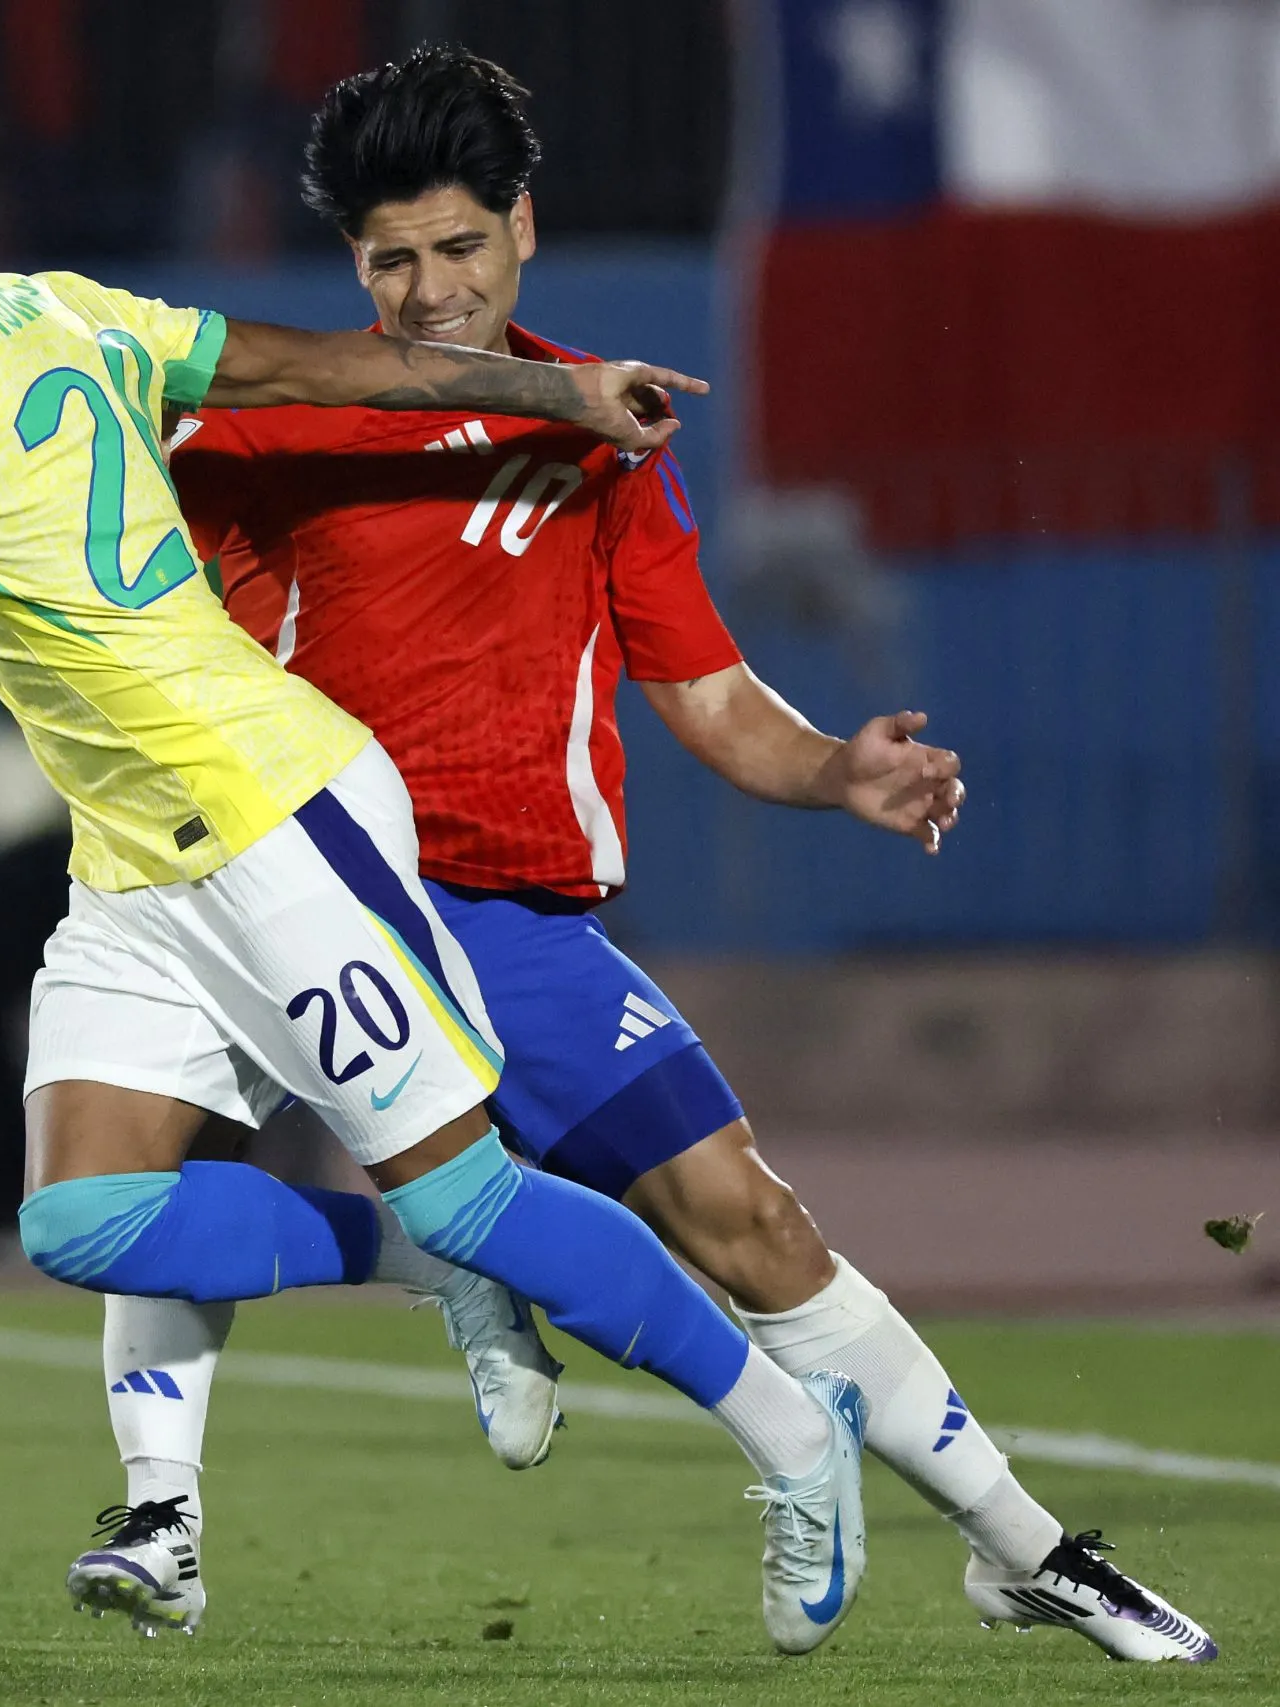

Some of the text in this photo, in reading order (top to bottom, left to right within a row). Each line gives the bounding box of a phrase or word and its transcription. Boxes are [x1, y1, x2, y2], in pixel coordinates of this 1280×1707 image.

[14, 328, 197, 610] 20
[460, 453, 584, 558] 10
[285, 959, 410, 1086] 20
